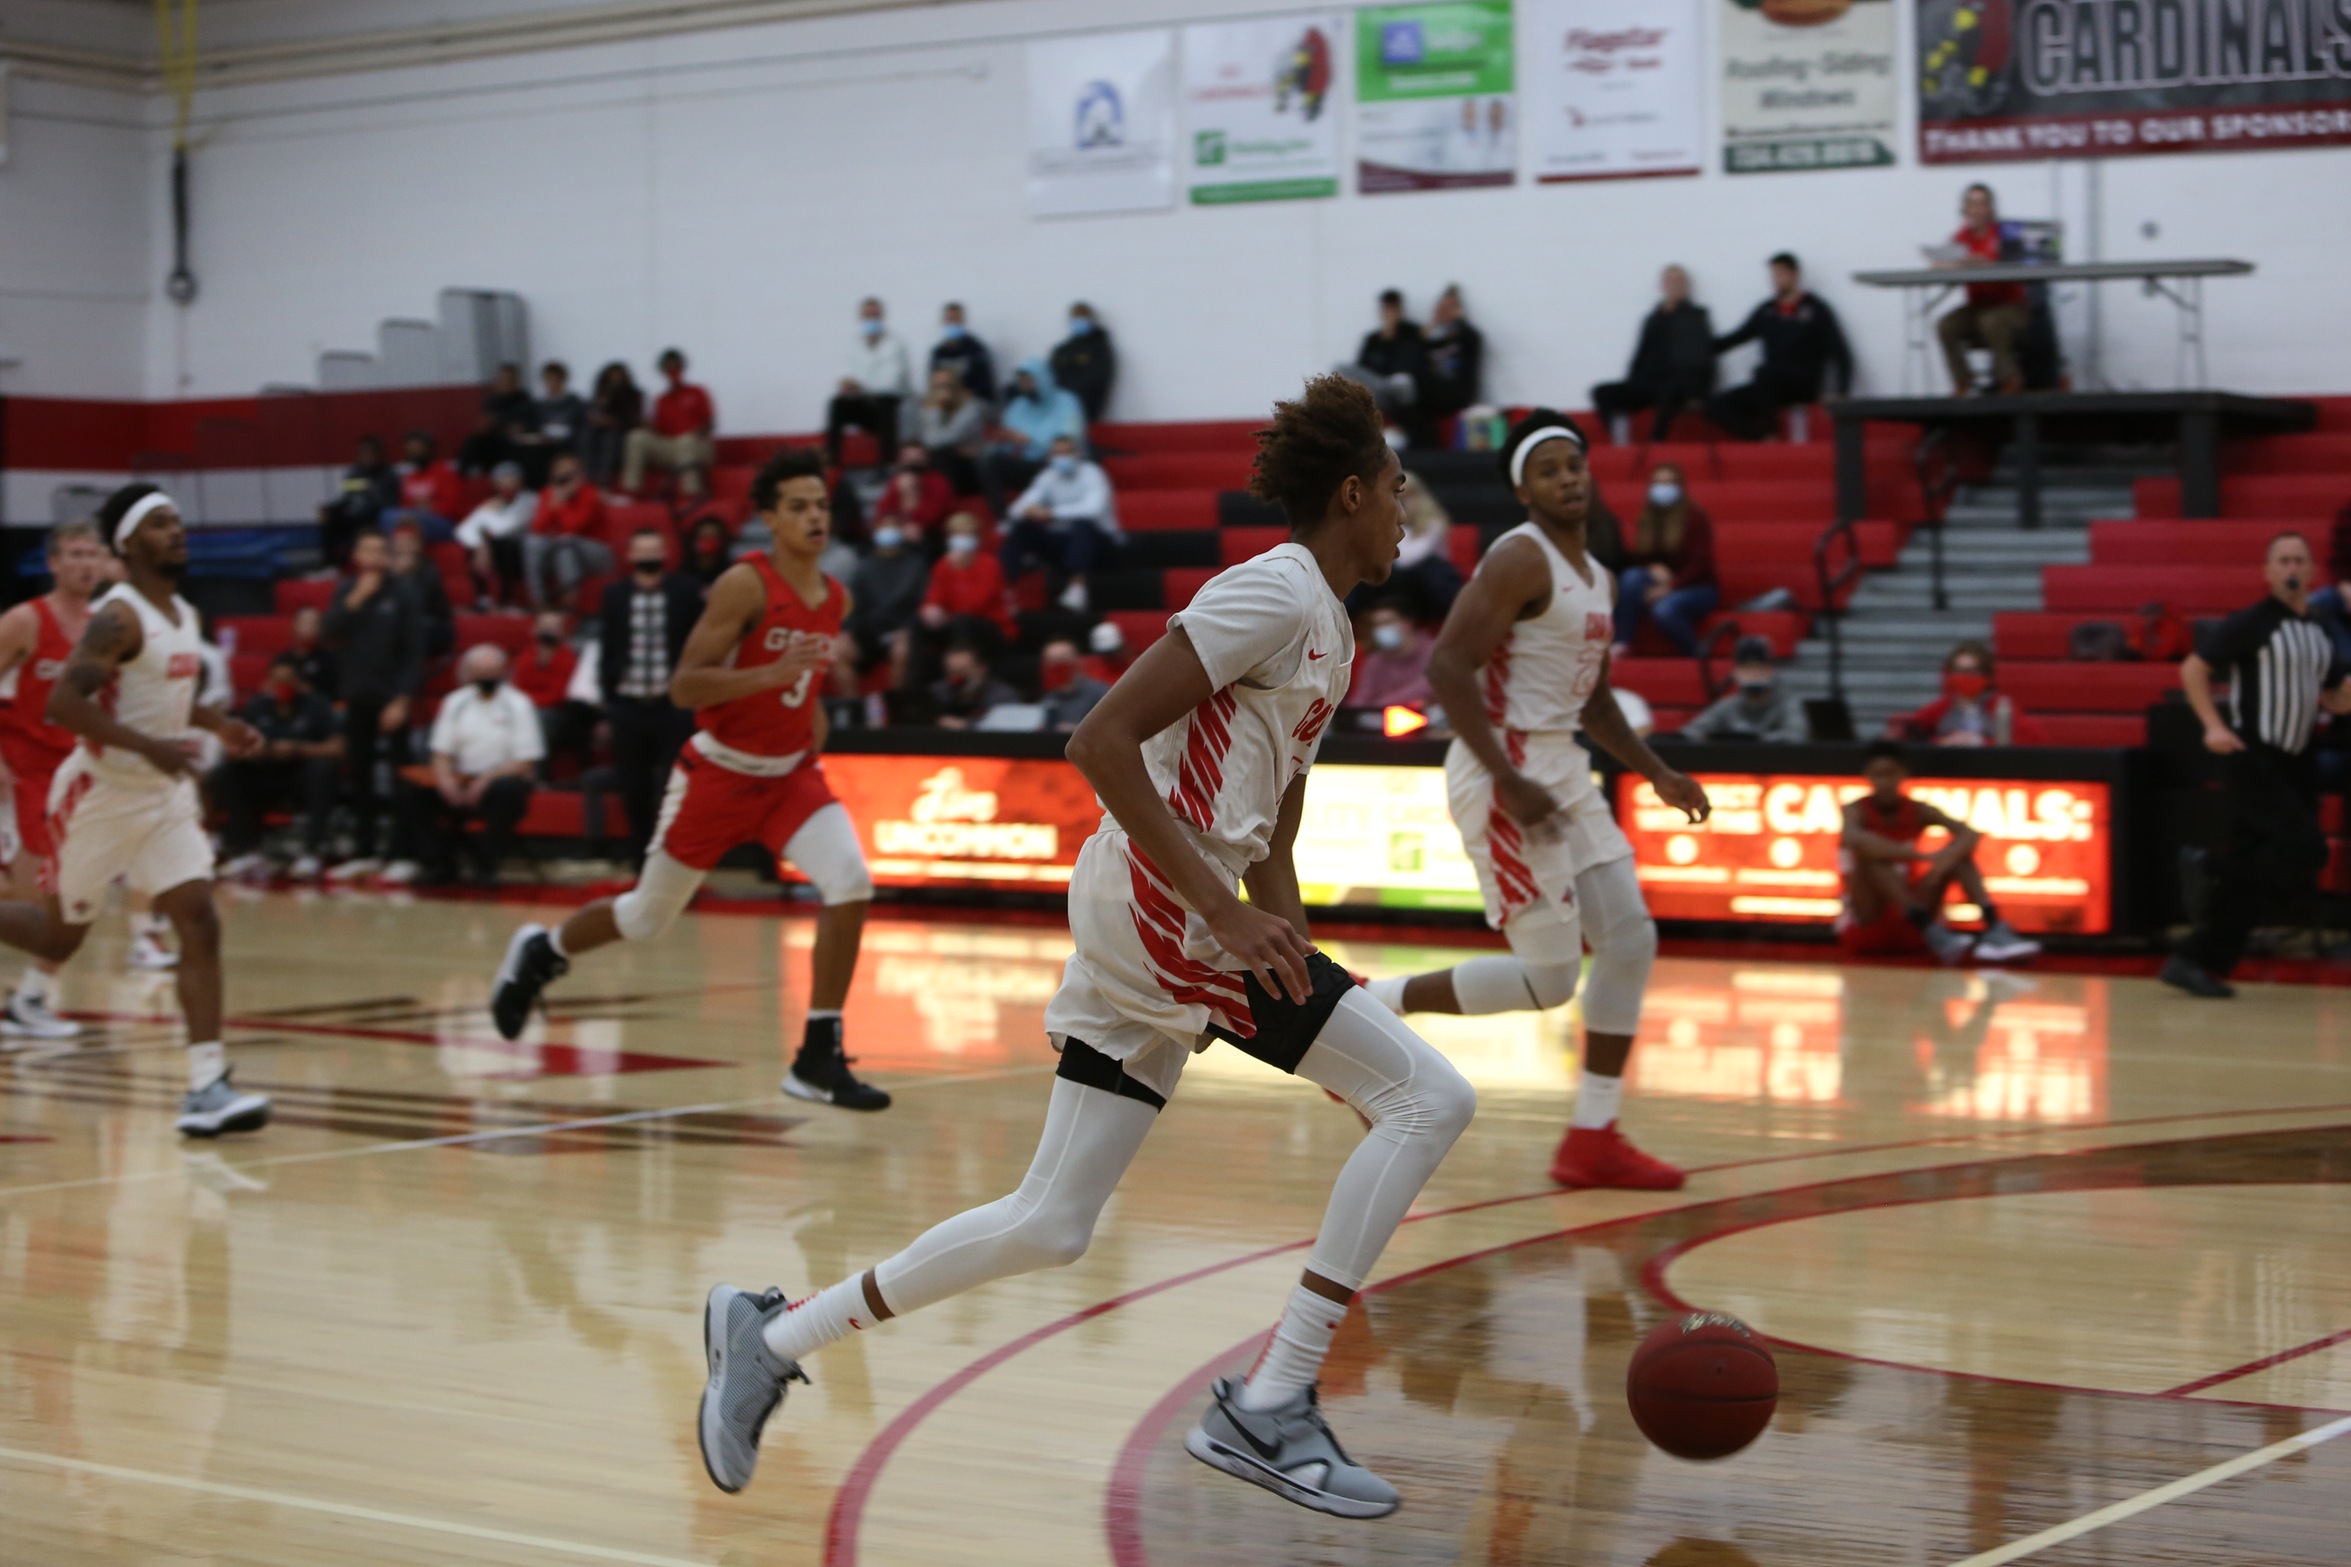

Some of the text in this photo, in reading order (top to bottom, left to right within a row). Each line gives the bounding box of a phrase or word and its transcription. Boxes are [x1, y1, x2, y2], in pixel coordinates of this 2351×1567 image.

[1925, 125, 2022, 154] THANK
[2025, 121, 2088, 149] YOU
[2093, 119, 2134, 146] TO
[2139, 115, 2205, 143] OUR
[1764, 783, 2094, 842] CANALS:
